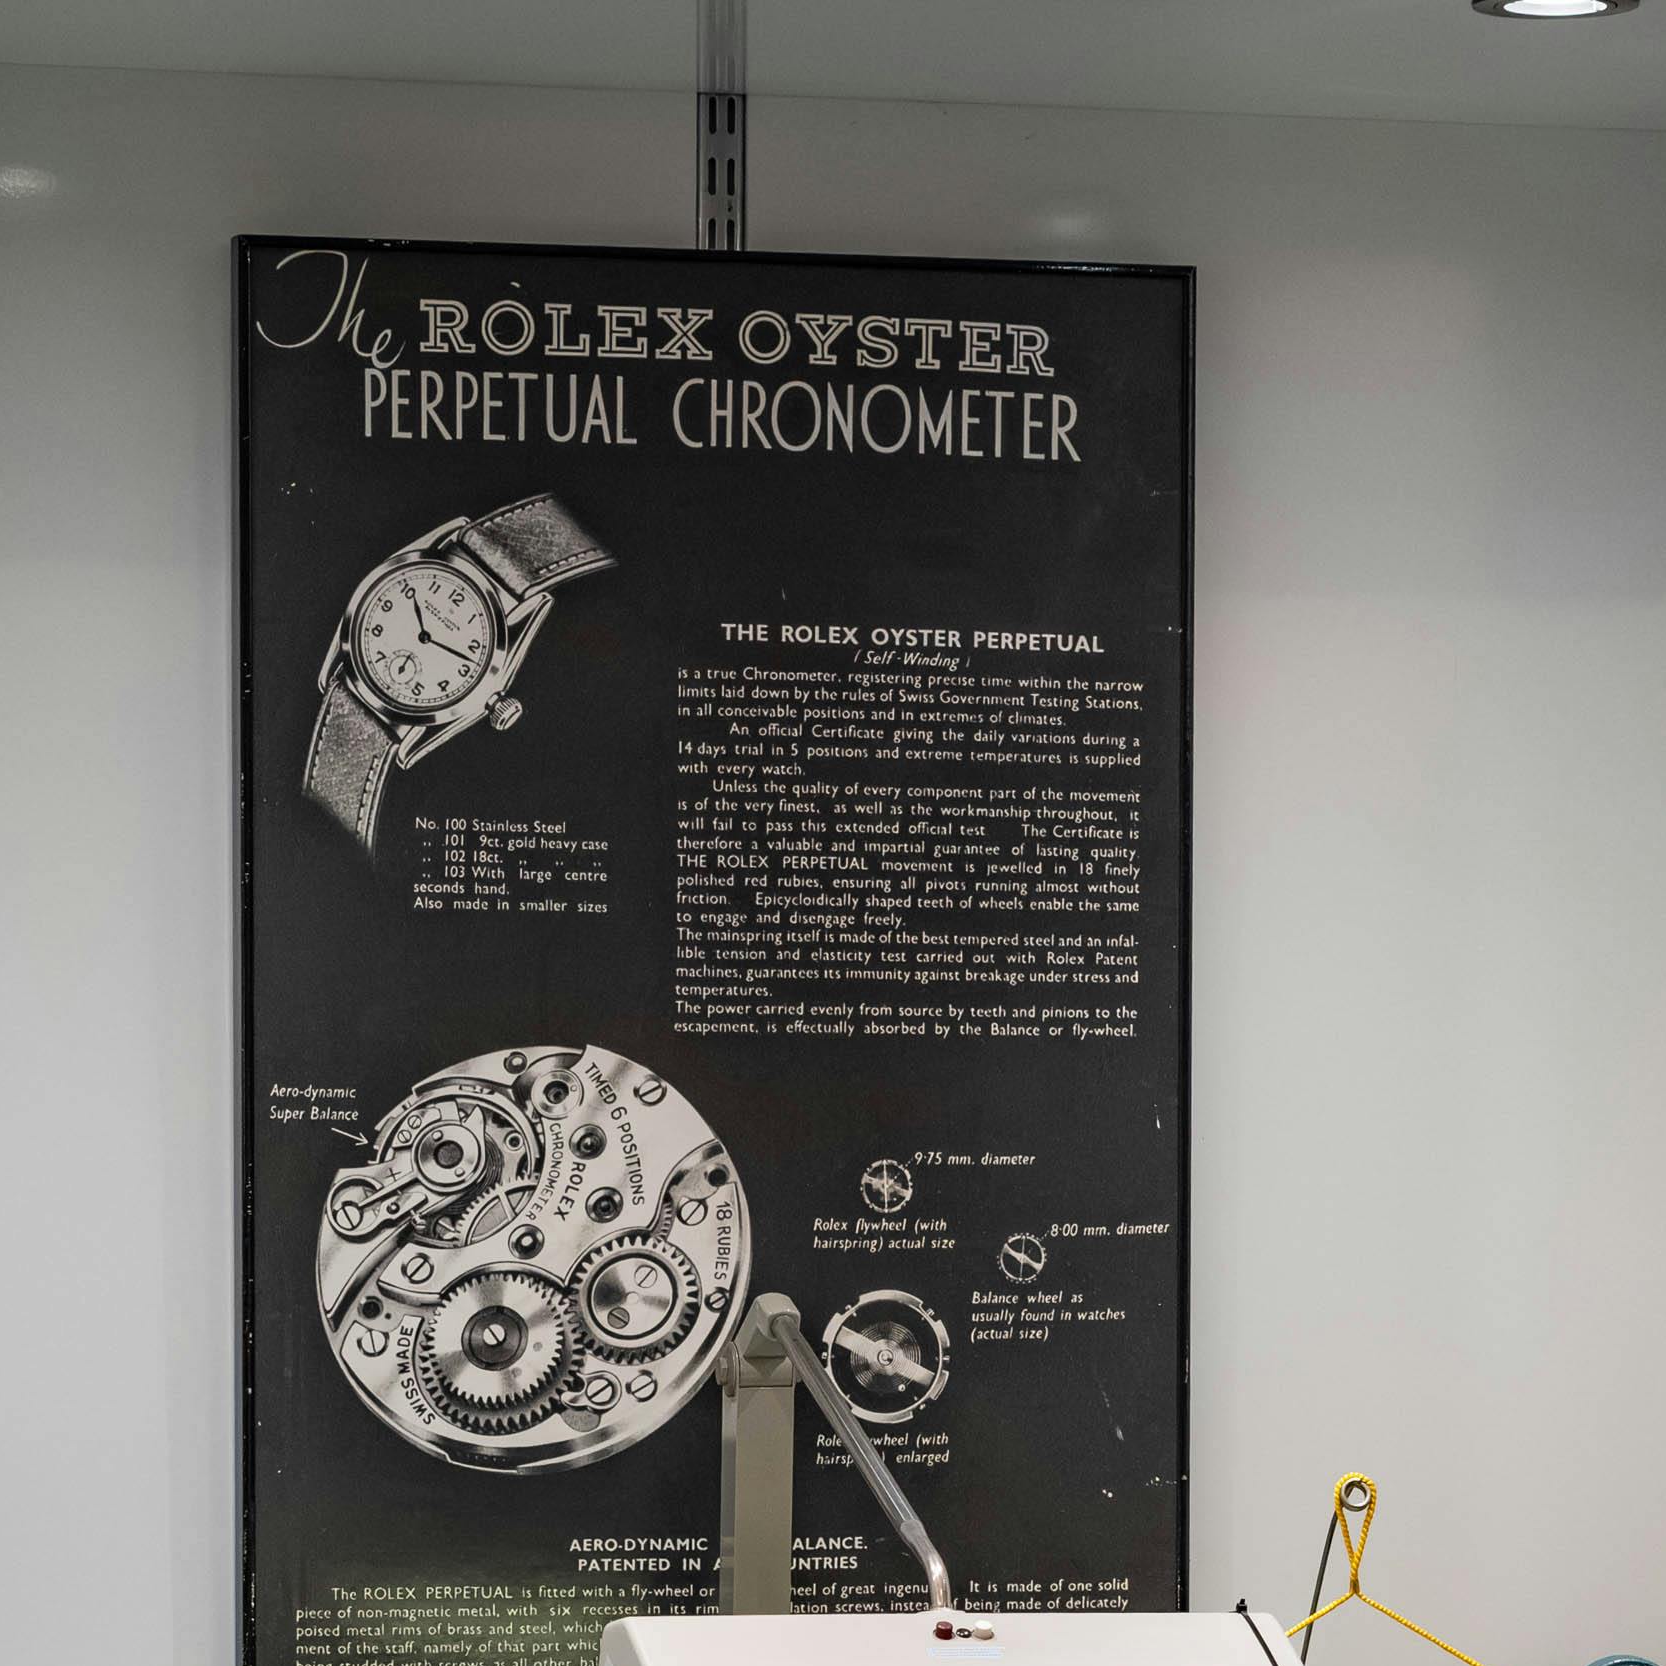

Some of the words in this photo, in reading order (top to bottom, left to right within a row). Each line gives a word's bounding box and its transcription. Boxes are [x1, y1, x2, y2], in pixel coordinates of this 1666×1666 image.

[255, 250, 405, 369] The
[420, 298, 714, 361] ROLEX
[738, 310, 1054, 377] OYSTER
[364, 367, 637, 445] PERPETUAL
[673, 377, 1081, 461] CHRONOMETER
[401, 583, 416, 600] 10
[448, 589, 465, 607] 12
[721, 623, 768, 642] THE
[781, 625, 859, 645] ROLEX
[871, 628, 961, 648] OYSTER
[974, 631, 1104, 653] PERPETUAL
[678, 707, 690, 716] in
[696, 703, 712, 716] all
[718, 704, 797, 718] conceivable
[804, 708, 865, 722] positions
[871, 707, 895, 721] and
[901, 711, 914, 721] in
[920, 712, 983, 723] extremes
[989, 710, 1003, 723] of
[1008, 711, 1066, 726] climates.
[415, 817, 439, 830] No.
[445, 818, 467, 831] 100
[472, 818, 528, 833] Stainless
[533, 820, 566, 834] Steel
[445, 834, 464, 846] 101
[479, 834, 503, 848] 9ct.
[507, 836, 536, 852] gold
[541, 837, 577, 853] heavy
[582, 841, 608, 851] case
[445, 849, 466, 862] 102
[473, 850, 503, 863] 18ct.
[445, 865, 465, 878] 103
[471, 866, 505, 879] With
[519, 867, 552, 884] large
[565, 872, 607, 882] centre
[677, 854, 707, 868] THE
[717, 854, 769, 868] ROLEX
[783, 855, 868, 870] PERPETUAL
[881, 861, 953, 872] movement
[965, 863, 975, 873] is
[987, 861, 1042, 876] jewelled
[1054, 863, 1066, 875] in
[1080, 862, 1093, 875] 18
[1105, 862, 1140, 881] finely
[413, 881, 465, 894] seconds
[474, 882, 509, 895] hand.
[414, 896, 443, 909] Also
[453, 897, 488, 910] made
[497, 898, 509, 910] in
[519, 899, 568, 912] smaller
[577, 903, 607, 913] sizes
[675, 1000, 701, 1014] The
[707, 1004, 751, 1018] power
[756, 1002, 804, 1015] carried
[810, 1003, 854, 1019] evenly
[859, 1003, 892, 1016] from
[899, 1007, 943, 1017] source
[949, 1004, 964, 1021] by
[970, 1005, 1006, 1018] teeth
[1012, 1005, 1036, 1018] and
[1042, 1006, 1089, 1022] pinions
[1095, 1008, 1110, 1019] to
[1116, 1005, 1138, 1019] the
[584, 1062, 617, 1104] TIMED
[270, 1083, 356, 1102] Aero-dynamic
[270, 1105, 305, 1123] Super
[310, 1106, 359, 1121] Balance
[610, 1106, 627, 1121] 6
[617, 1122, 645, 1206] POSITIONS
[947, 1155, 975, 1165] mm.
[981, 1152, 1036, 1165] diameter
[525, 1122, 564, 1221] CHRONOMETER
[554, 1161, 586, 1222] ROLEX
[716, 1200, 733, 1221] 18
[813, 1218, 848, 1231] Rolex
[855, 1218, 907, 1235] flywheel
[914, 1218, 947, 1235] (with
[1083, 1226, 1110, 1236] mm.
[1116, 1222, 1170, 1235] diameter
[714, 1226, 731, 1281] RUBIES
[813, 1236, 883, 1253] hairspring)
[888, 1236, 925, 1249] actual
[931, 1239, 955, 1249] size
[972, 1291, 1019, 1304] Balance
[1027, 1290, 1063, 1304] wheel
[1071, 1294, 1083, 1303] as
[972, 1309, 1015, 1325] usually
[1020, 1308, 1055, 1321] found
[1060, 1310, 1072, 1321] in
[1077, 1307, 1125, 1320] watches
[971, 1327, 1013, 1343] (actual
[1019, 1326, 1049, 1342] size)
[396, 1326, 414, 1375] MADE
[400, 1377, 436, 1425] SWISS
[916, 1432, 949, 1448] (with
[896, 1449, 950, 1466] enlarged
[569, 1537, 708, 1552] AERO-DYNAMIC
[578, 1558, 671, 1572] PATENTED
[683, 1557, 701, 1571] IN
[331, 1587, 357, 1601] The
[364, 1586, 416, 1600] ROLEX
[426, 1585, 513, 1599] PERPETUAL
[522, 1587, 532, 1599] is
[539, 1585, 576, 1598] fitted
[582, 1584, 613, 1598] with
[618, 1588, 625, 1597] a
[631, 1584, 693, 1601] fly-wheel
[699, 1588, 715, 1597] or
